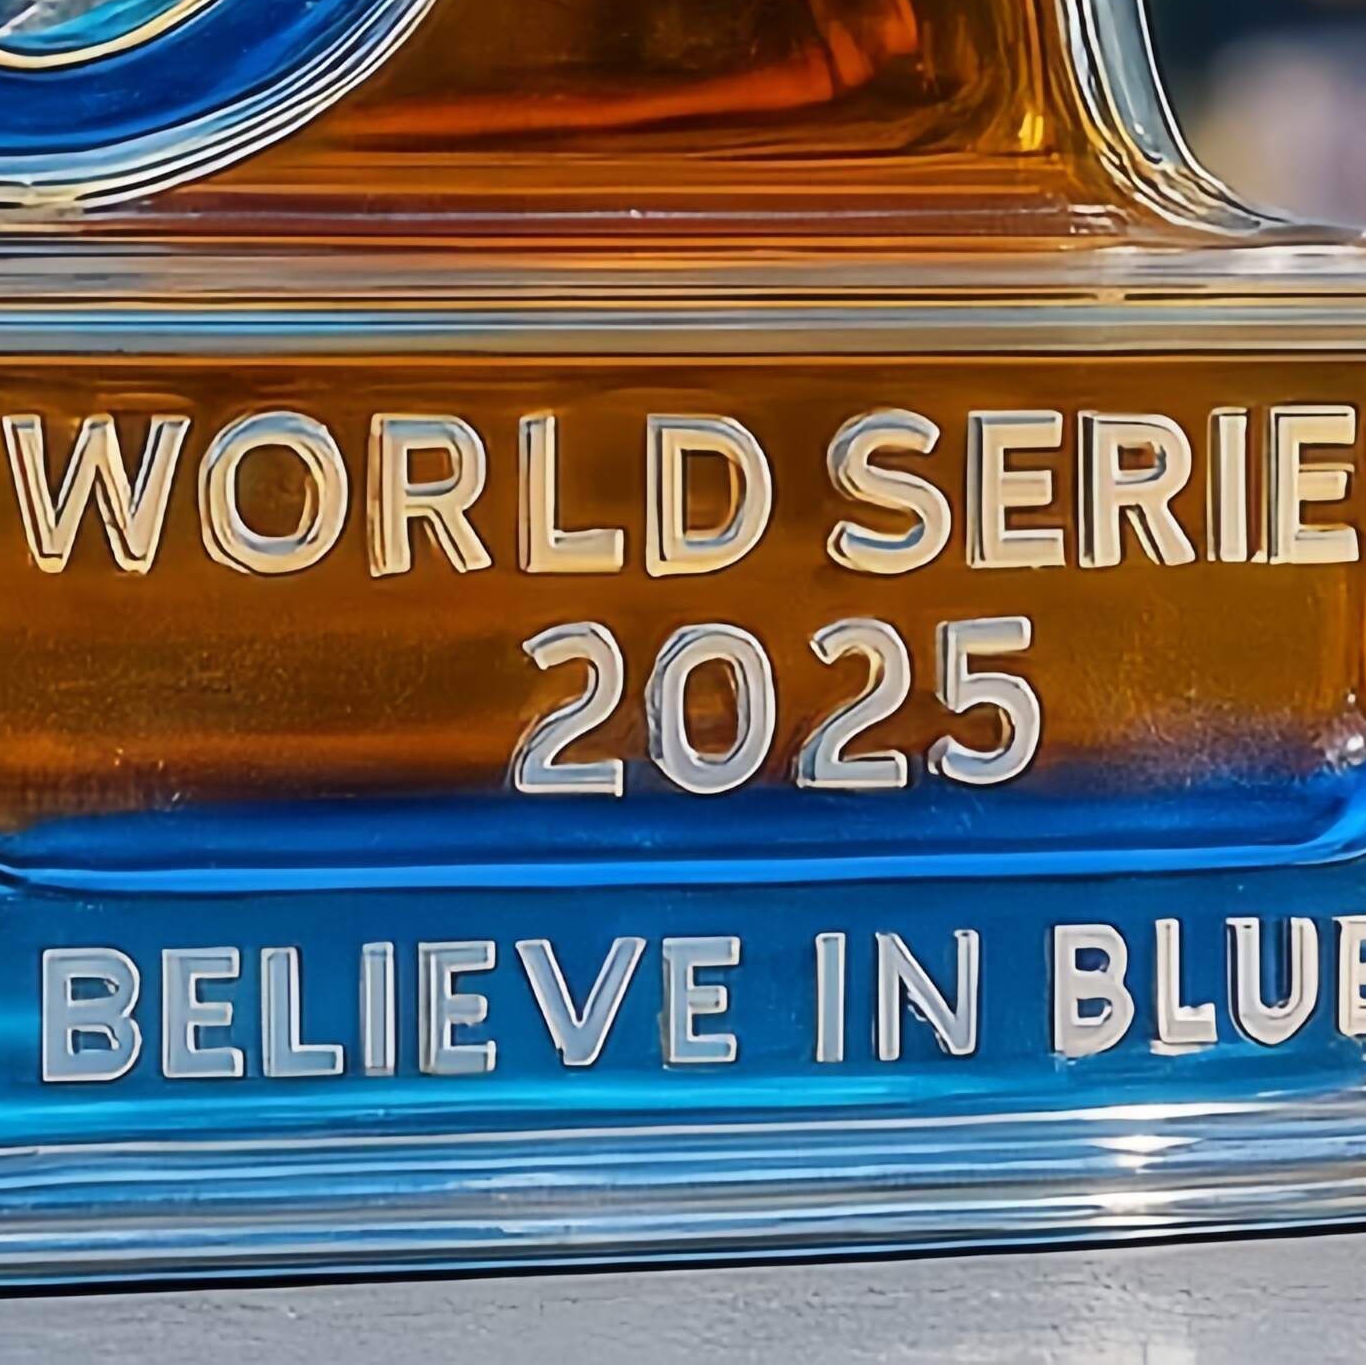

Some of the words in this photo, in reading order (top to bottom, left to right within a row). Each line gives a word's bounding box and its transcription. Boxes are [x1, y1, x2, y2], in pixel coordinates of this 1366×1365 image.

[3, 411, 775, 577] WORLD
[512, 617, 1041, 795] 2025
[39, 937, 741, 1083] BELIEVE
[813, 929, 981, 1063] IN
